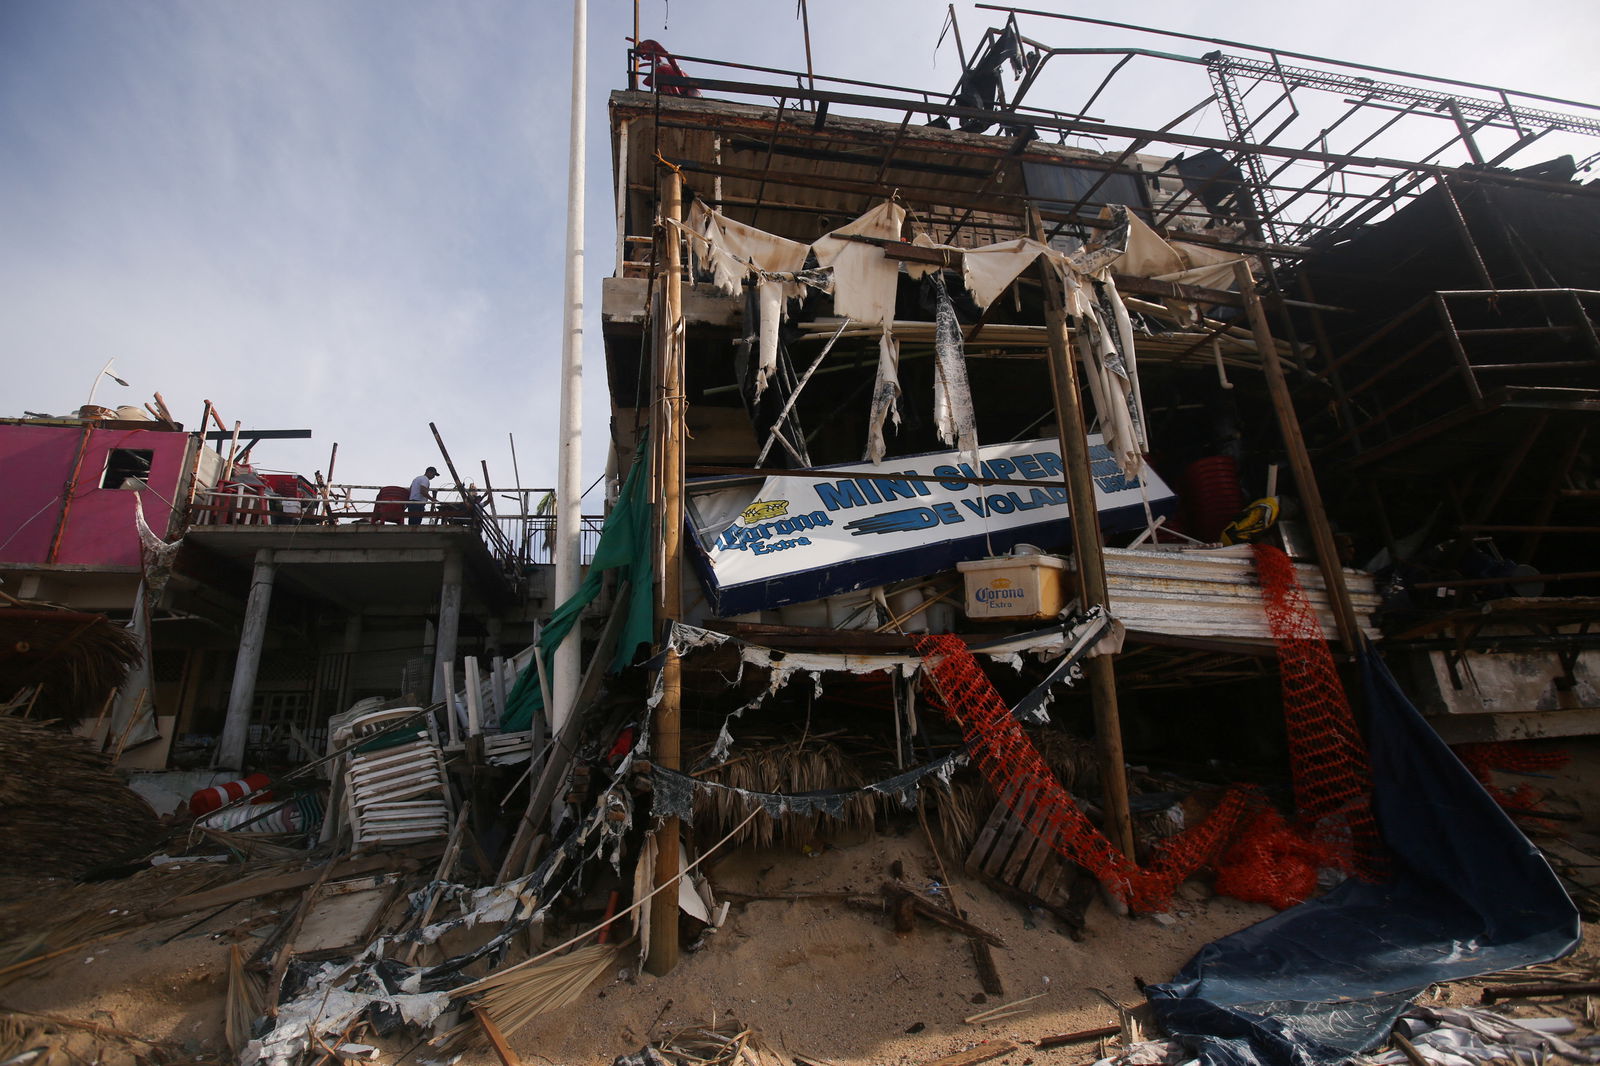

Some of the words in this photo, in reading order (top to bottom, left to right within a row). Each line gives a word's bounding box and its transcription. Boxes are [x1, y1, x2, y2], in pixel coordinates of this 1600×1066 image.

[813, 469, 931, 512] MINI
[933, 451, 1064, 491] SUPER
[872, 501, 965, 535] DE
[961, 486, 1068, 518] VOLAD
[715, 510, 834, 552] Corona
[749, 536, 812, 556] Extra
[975, 587, 1025, 603] Corona
[989, 600, 1013, 609] Extra
